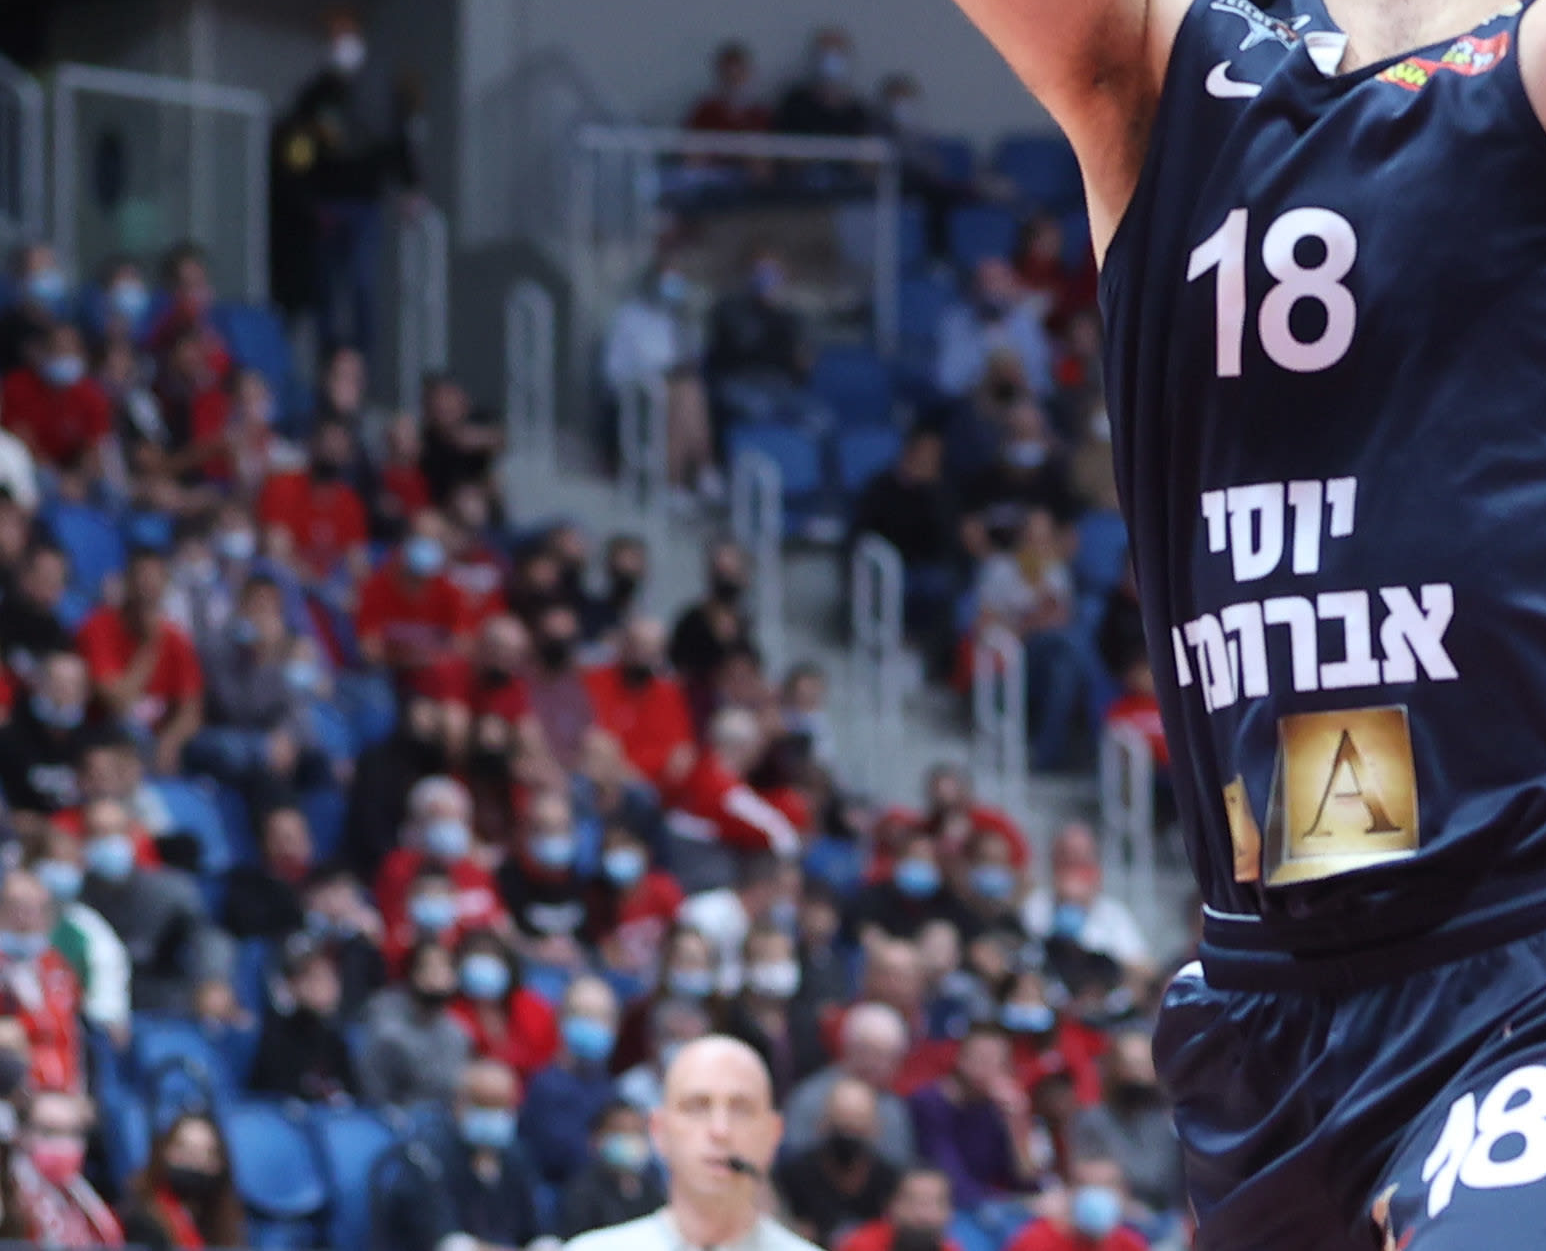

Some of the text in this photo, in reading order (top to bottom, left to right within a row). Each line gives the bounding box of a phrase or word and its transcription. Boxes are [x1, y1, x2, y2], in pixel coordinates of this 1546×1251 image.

[1187, 206, 1357, 378] 18
[1201, 477, 1357, 582] יוסי
[1303, 728, 1402, 838] A
